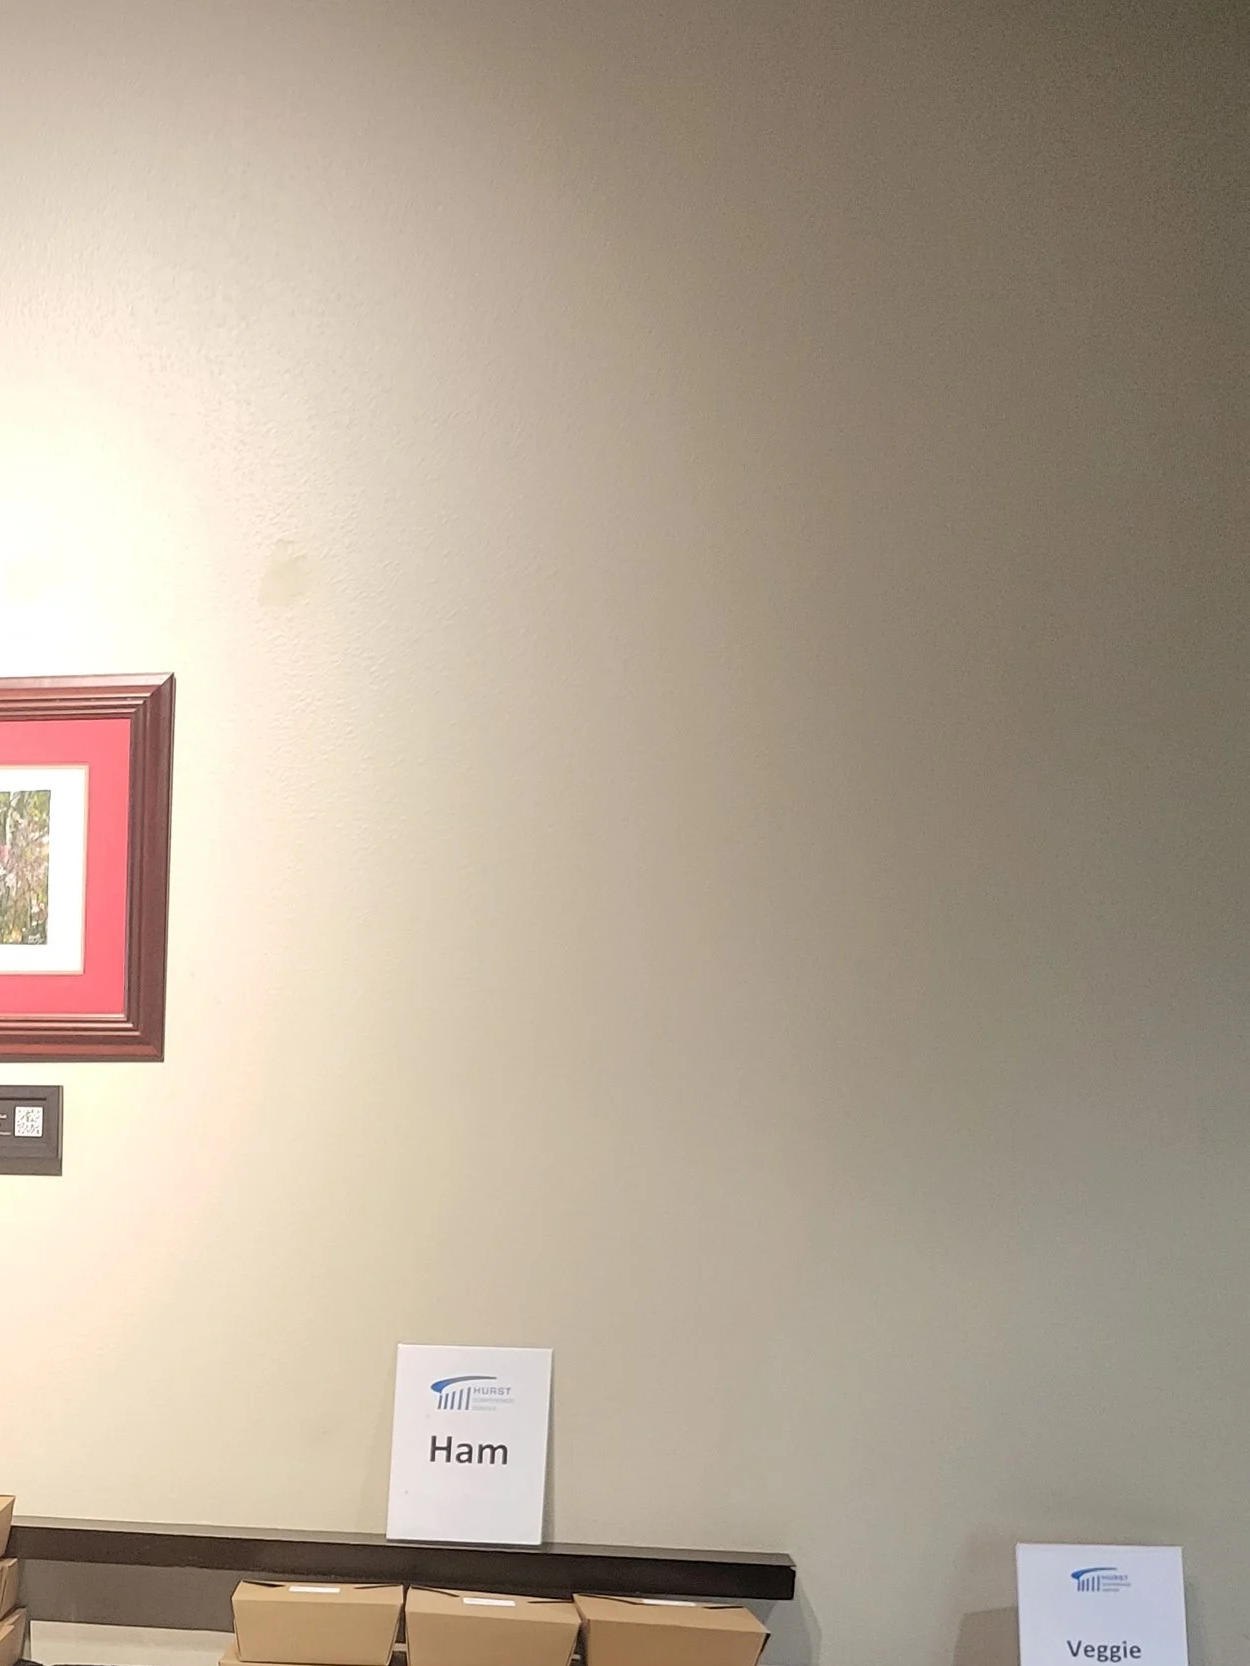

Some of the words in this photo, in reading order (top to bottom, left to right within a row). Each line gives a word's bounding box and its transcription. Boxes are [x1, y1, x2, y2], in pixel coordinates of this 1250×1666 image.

[473, 1386, 512, 1396] HURST
[429, 1435, 509, 1465] Ham
[1066, 1639, 1142, 1663] Veggie
